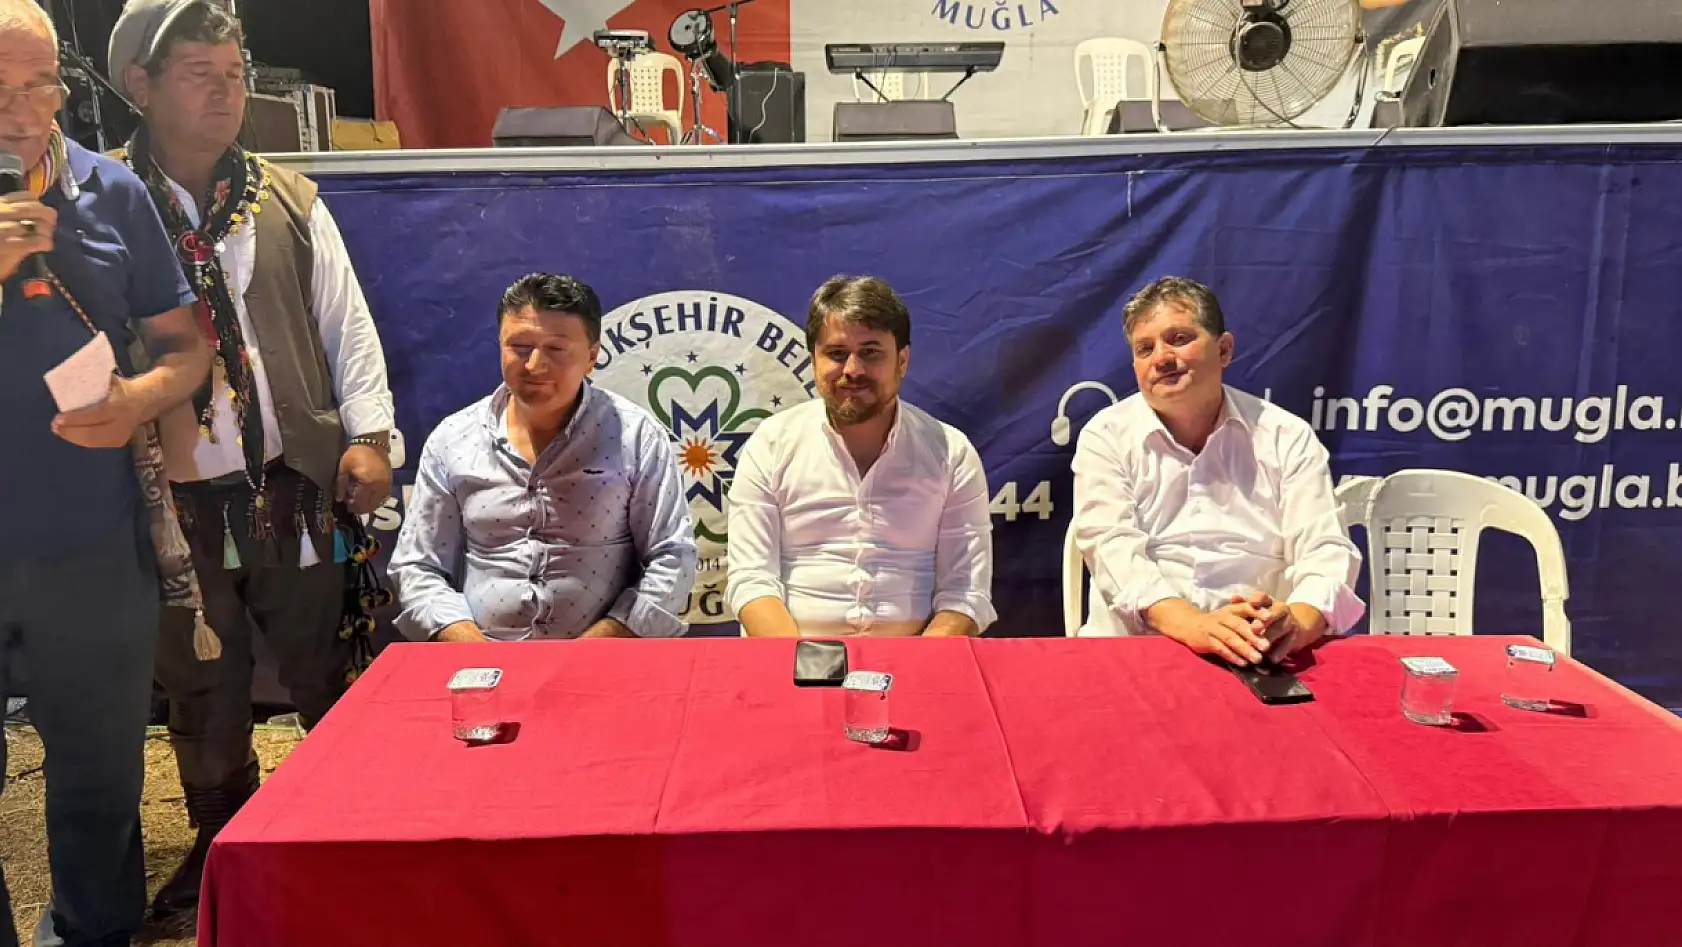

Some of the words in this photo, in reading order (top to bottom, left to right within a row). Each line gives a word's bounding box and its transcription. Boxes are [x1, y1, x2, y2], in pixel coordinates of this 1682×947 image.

[931, 0, 1059, 30] MUĞLA
[1311, 384, 1682, 443] info@mugla.
[989, 481, 1054, 521] 44
